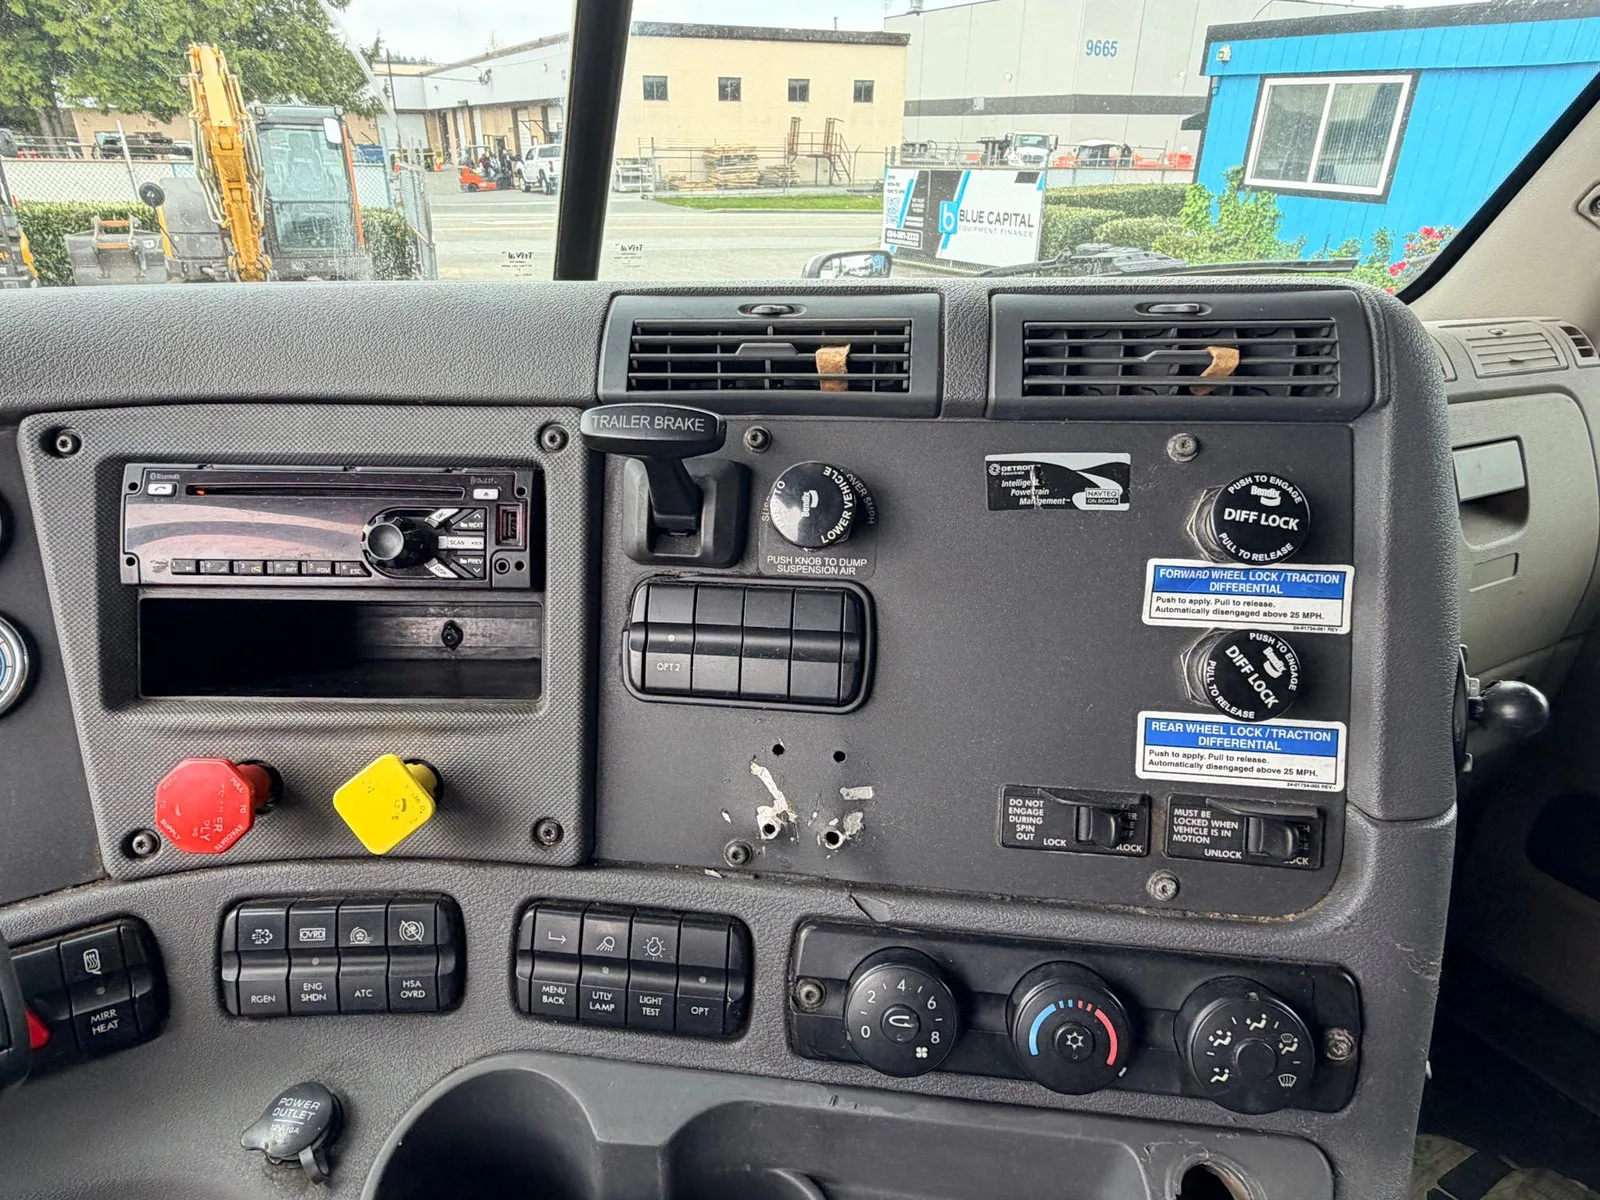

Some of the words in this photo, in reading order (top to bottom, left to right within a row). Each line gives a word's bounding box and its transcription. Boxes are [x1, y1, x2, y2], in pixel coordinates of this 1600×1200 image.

[1085, 39, 1118, 58] 9665
[959, 209, 985, 223] BLUE
[987, 211, 1035, 228] CAPITAL
[959, 226, 998, 236] EQUIPMENT
[1000, 228, 1034, 238] FINANCE
[591, 415, 650, 429] TRAILER
[654, 416, 705, 432] BRAKE
[774, 480, 786, 494] TO
[823, 466, 853, 509] VEHICLE
[846, 473, 867, 497] OVER
[1228, 476, 1254, 494] PUSH
[1254, 474, 1268, 483] TO
[1269, 476, 1303, 504] ENGAGE
[1250, 485, 1281, 499] Bendix
[801, 491, 811, 517] Bendix
[1224, 507, 1258, 523] DIFF
[1260, 512, 1300, 531] LOCK
[821, 510, 852, 544] LOWER
[1218, 532, 1236, 554] PULL
[1239, 549, 1250, 560] TO
[1252, 543, 1294, 562] RELEASE
[767, 555, 793, 564] PUSH
[795, 556, 822, 566] KNOB
[823, 557, 837, 566] TO
[839, 558, 868, 567] DUMP
[776, 564, 839, 575] SUSPENSION
[839, 566, 856, 575] AIR
[1160, 568, 1210, 580] FORWARD
[1211, 570, 1247, 581] WHEEL
[1209, 581, 1284, 594] DIFFERENTIAL
[1156, 596, 1176, 604] Push
[1189, 598, 1212, 607] apply.
[1214, 598, 1232, 606] Pull
[1243, 600, 1276, 608] release.
[1155, 606, 1211, 616] Automatically
[1212, 607, 1260, 617] disengaged
[1262, 610, 1287, 618] above
[1302, 612, 1324, 620] MPH.
[656, 662, 673, 671] OPT
[674, 663, 681, 672] 2
[1249, 632, 1276, 645] PUSH
[1276, 641, 1287, 653] TO
[1286, 653, 1298, 691] ENGAGE
[1206, 660, 1217, 684] PULL
[1225, 645, 1254, 674] DIFF
[1248, 673, 1280, 709] LOCK
[1208, 685, 1219, 696] TO
[1215, 697, 1255, 719] RELEASE
[1152, 721, 1183, 732] REAR
[1186, 723, 1227, 735] WHEEL
[1198, 736, 1282, 751] DIFFERENTIAL
[1149, 750, 1170, 758] Push
[1171, 751, 1180, 759] to
[1182, 752, 1206, 762] apply.
[1208, 753, 1224, 761] Pull
[1226, 754, 1235, 762] to
[1236, 755, 1270, 764] release.
[1148, 759, 1203, 770] Automatically
[1205, 762, 1254, 774] disengaged
[1256, 765, 1282, 774] above
[1283, 767, 1294, 775] 25
[1296, 769, 1318, 777] MPH.
[230, 776, 245, 793] PULL
[240, 804, 247, 814] TO
[1009, 798, 1023, 807] DO
[1025, 799, 1045, 808] NOT
[1008, 807, 1044, 817] ENGAGE
[1174, 808, 1199, 818] MUST
[1200, 810, 1211, 818] BE
[1009, 816, 1043, 825] DURING
[1174, 817, 1209, 827] LOCKED
[1211, 820, 1239, 829] WHEN
[161, 818, 182, 841] SUPPLY
[1016, 824, 1035, 833] SPIN
[1173, 825, 1209, 836] VEHICLE
[1211, 828, 1219, 836] IS
[1221, 829, 1231, 838] IN
[214, 824, 244, 851] EVACUATE
[1016, 832, 1035, 841] OUT
[1043, 838, 1067, 847] LOCK
[1173, 834, 1210, 844] MOTION
[1204, 848, 1242, 859] UNLOCK
[301, 928, 325, 941] OVRD
[303, 982, 323, 992] ENG
[402, 980, 423, 990] HSA
[542, 985, 567, 996] MENU
[897, 979, 907, 992] 4
[251, 994, 276, 1004] RGEN
[301, 992, 327, 1003] SHDN
[354, 988, 374, 998] ATC
[400, 989, 426, 999] OVRD
[542, 994, 565, 1005] BACK
[592, 990, 613, 1001] UTLY
[867, 989, 877, 1004] 2
[589, 1001, 615, 1012] LAMP
[639, 995, 663, 1006] LIGHT
[927, 995, 937, 1009] 6
[90, 1008, 118, 1025] MIRR
[641, 1006, 661, 1017] TEST
[690, 1006, 709, 1017] OPT
[92, 1019, 120, 1036] HEAT
[860, 1025, 870, 1039] 0
[930, 1030, 941, 1045] 8
[278, 1097, 320, 1111] POWER
[272, 1107, 316, 1121] OUTLET
